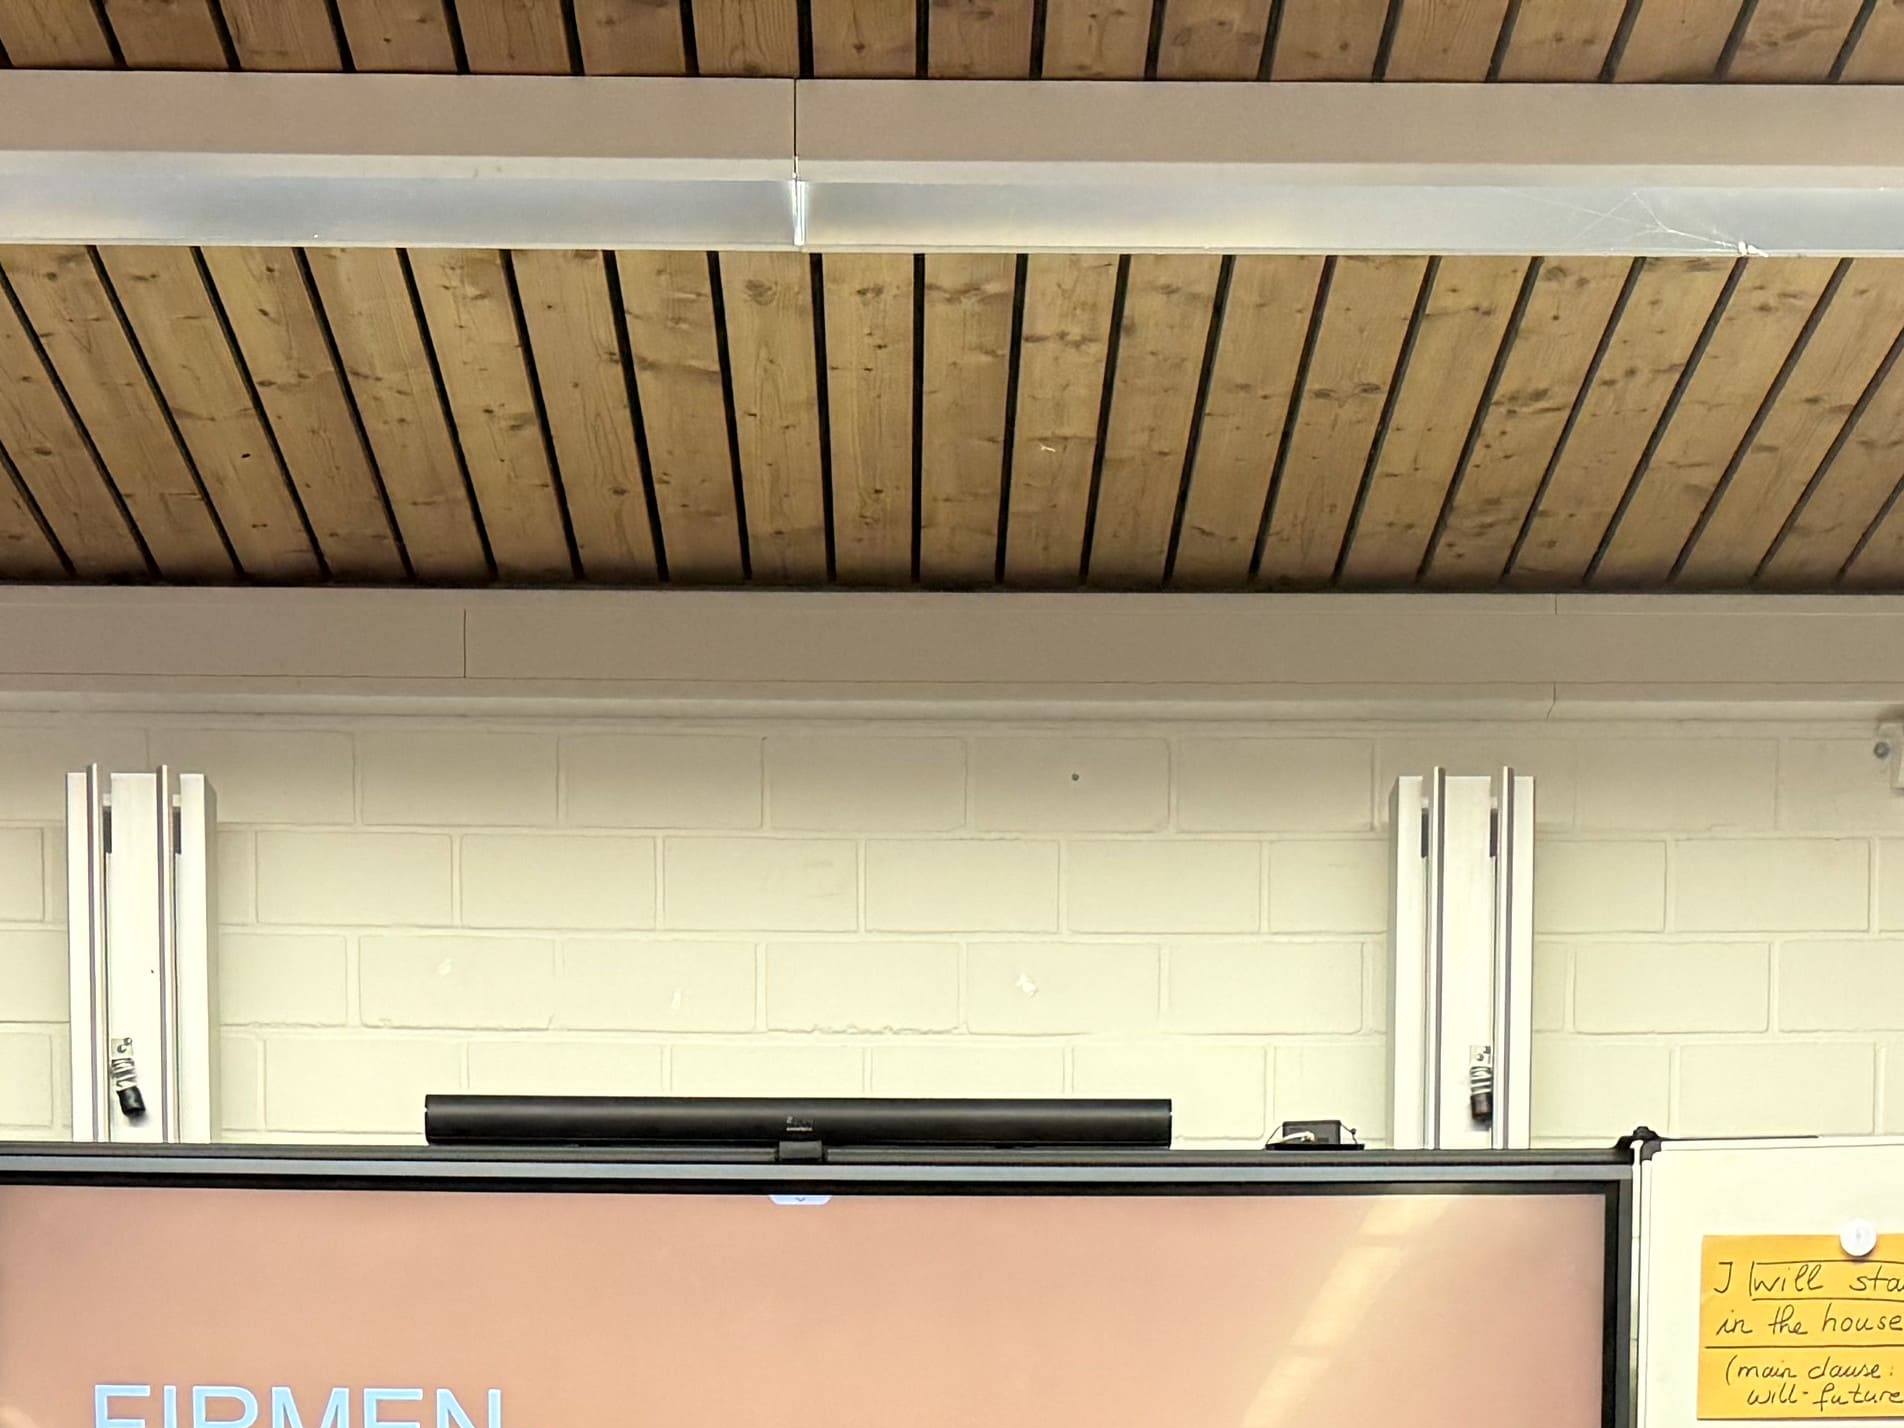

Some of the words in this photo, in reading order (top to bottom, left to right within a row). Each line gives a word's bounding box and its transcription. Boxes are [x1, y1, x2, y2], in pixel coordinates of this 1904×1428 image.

[1754, 1262, 1824, 1296] will
[1715, 1312, 1754, 1337] in
[1768, 1302, 1809, 1337] the
